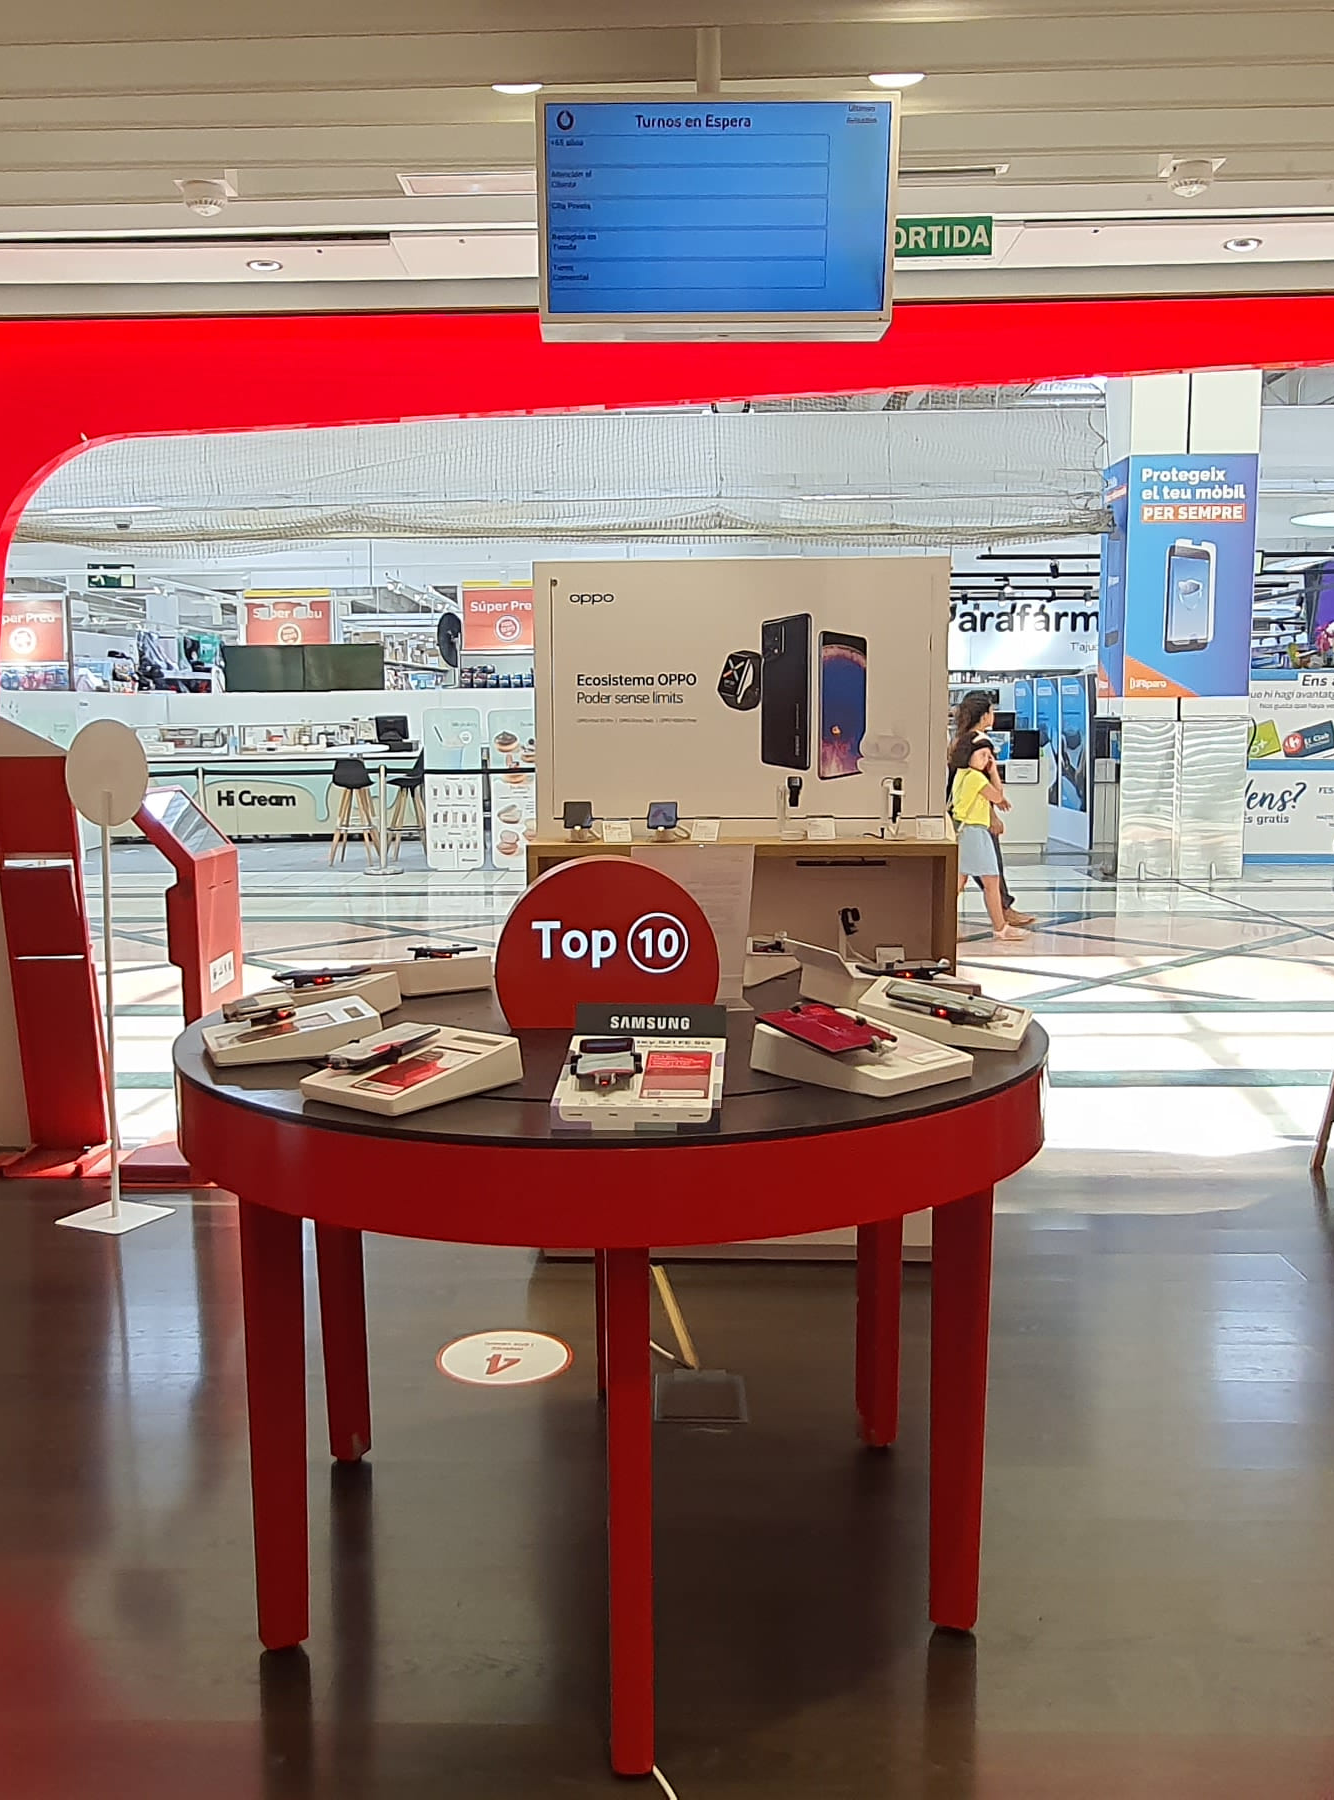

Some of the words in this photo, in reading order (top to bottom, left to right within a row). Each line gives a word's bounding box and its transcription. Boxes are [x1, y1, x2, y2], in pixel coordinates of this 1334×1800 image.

[636, 114, 682, 129] Turnos
[685, 116, 702, 128] en
[706, 114, 751, 131] Espera
[895, 224, 990, 249] ORTIDA
[1142, 467, 1226, 485] Protegeix
[1141, 486, 1160, 500] el
[1163, 486, 1191, 500] teu
[1195, 484, 1246, 500] mòbil
[1143, 506, 1175, 520] PER
[1178, 505, 1244, 520] SEMPRE
[569, 593, 615, 605] oppo
[470, 600, 509, 614] Súper
[576, 674, 655, 686] Ecosistema
[657, 673, 697, 686] OPPO
[1302, 674, 1328, 687] Ens
[576, 691, 611, 704] Poder
[614, 693, 650, 704] sense
[652, 691, 684, 704] limits
[1264, 690, 1273, 699] hi
[1274, 690, 1295, 702] hagi
[217, 790, 235, 806] Hi
[238, 790, 296, 806] Cream
[1256, 813, 1290, 825] gratis
[531, 920, 617, 969] Top
[638, 928, 679, 959] 10
[610, 1016, 691, 1030] SAMSUNG
[484, 1353, 522, 1377] 4
